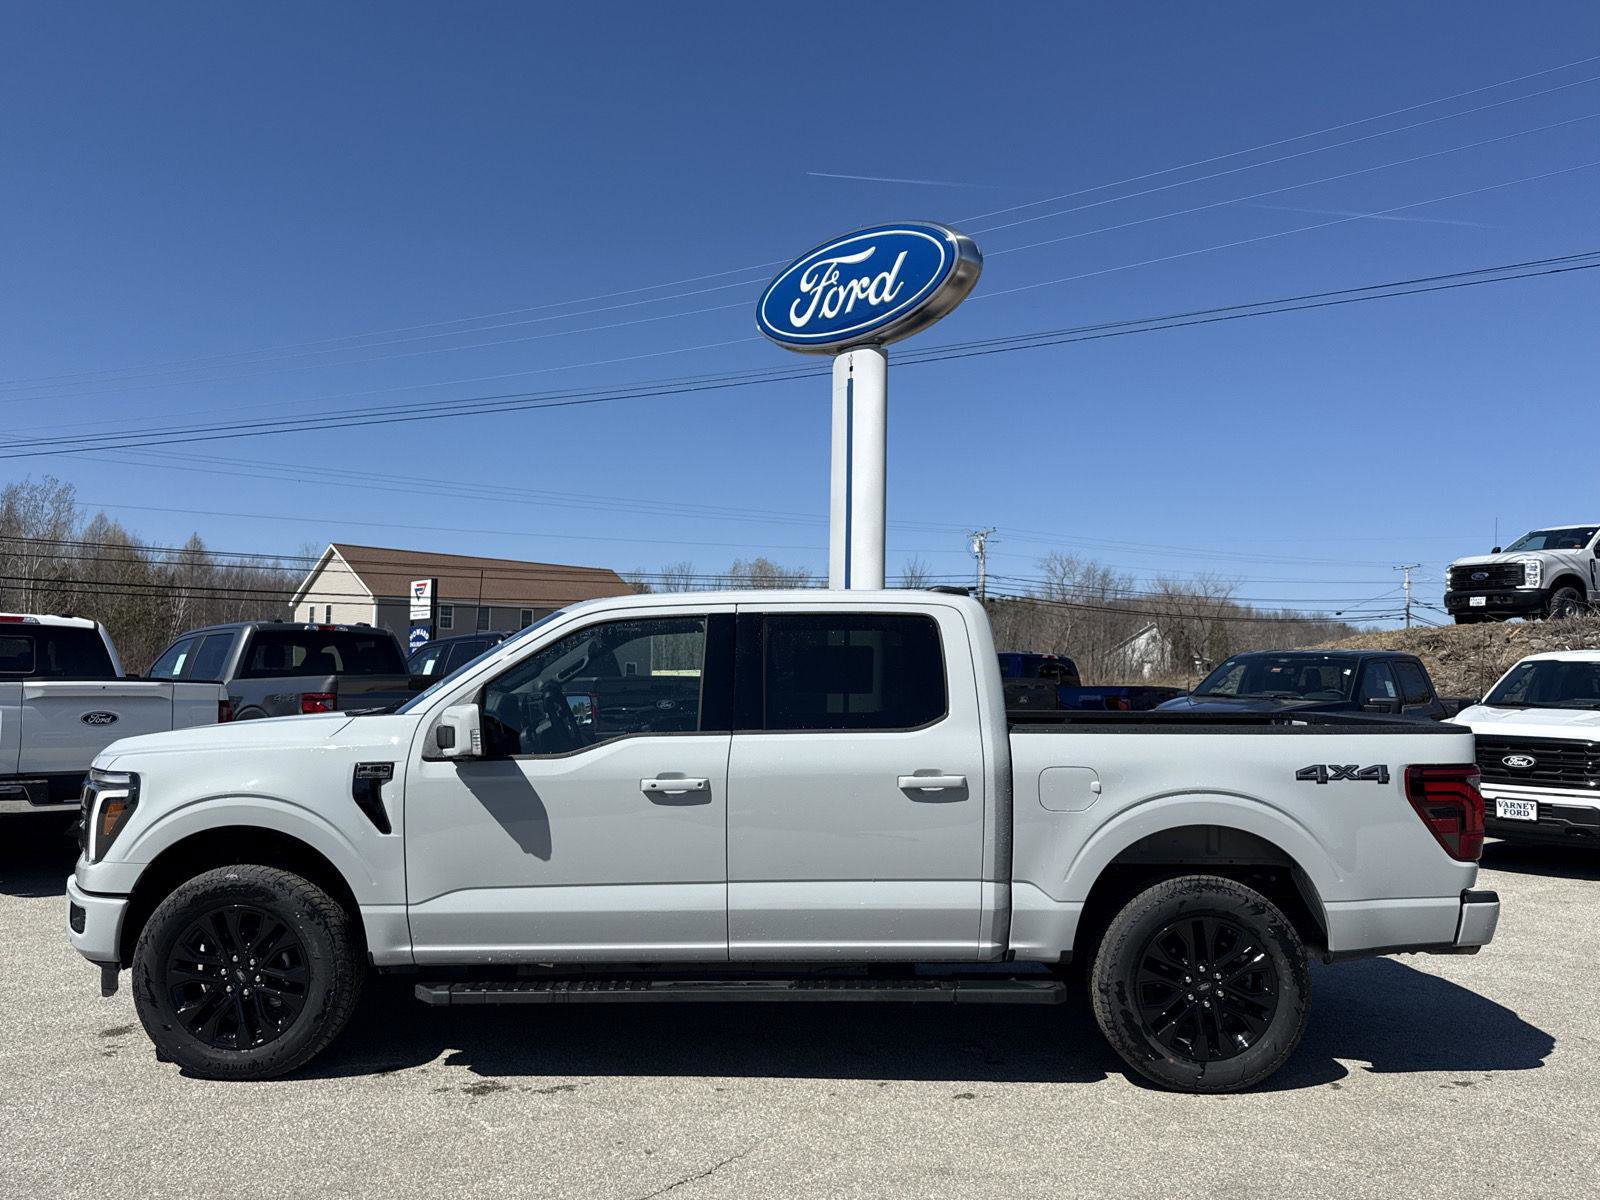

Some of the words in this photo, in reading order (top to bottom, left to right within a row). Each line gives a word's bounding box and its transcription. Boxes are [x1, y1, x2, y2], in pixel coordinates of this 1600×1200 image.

[789, 246, 908, 328] Ford
[88, 713, 112, 724] Ford
[1507, 757, 1528, 766] Ford
[1497, 800, 1535, 811] VARNEY
[1504, 809, 1530, 817] FORD
